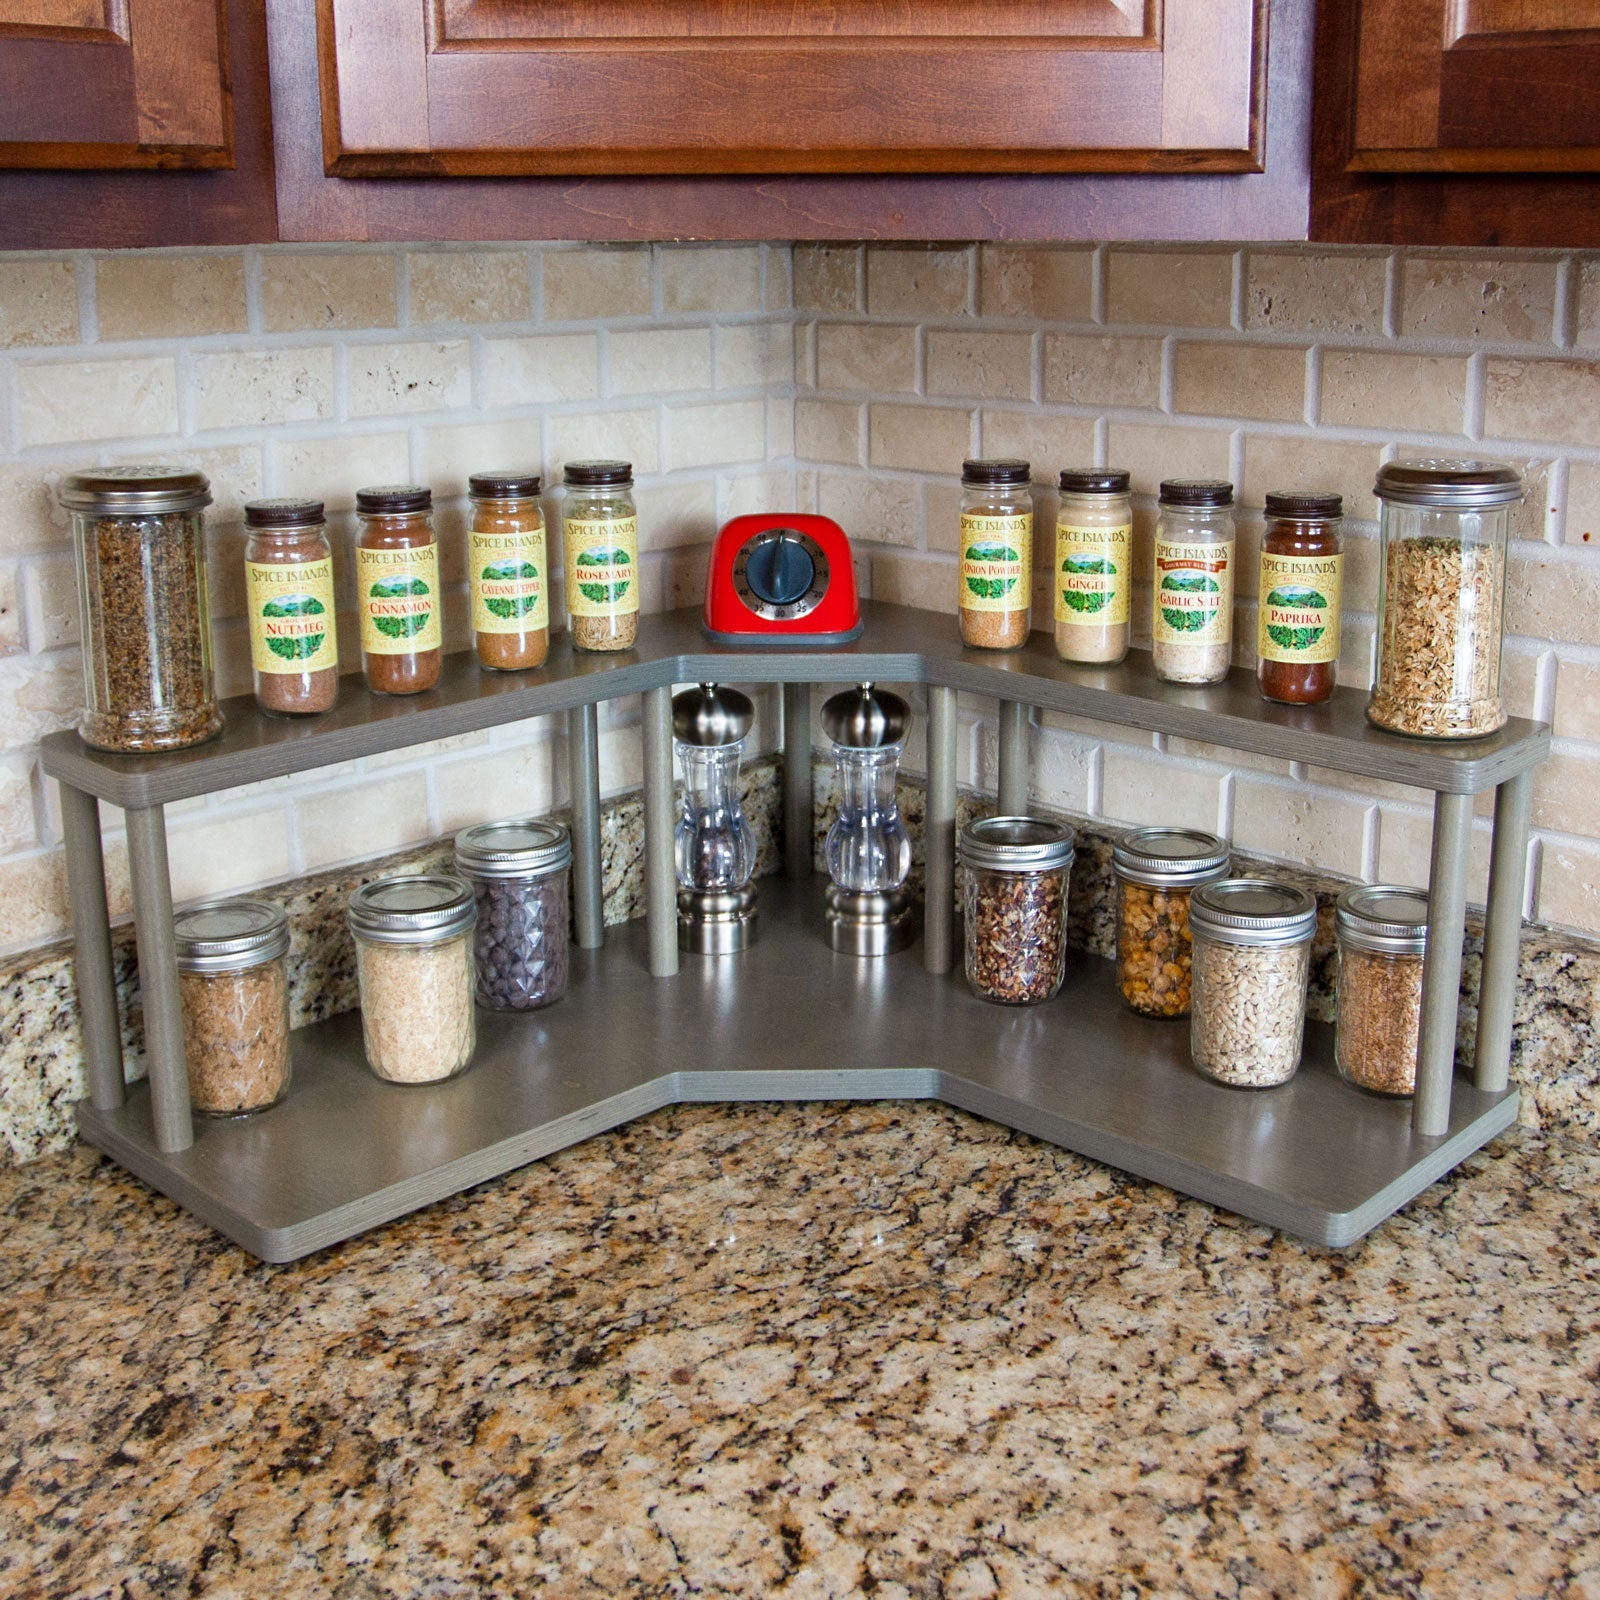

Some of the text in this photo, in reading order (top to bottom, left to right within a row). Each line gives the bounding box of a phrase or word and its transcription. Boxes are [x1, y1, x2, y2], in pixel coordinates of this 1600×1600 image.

[569, 523, 596, 535] SPICE
[961, 516, 1026, 531] SPICE ISLANDS
[473, 533, 543, 548] SPICE ISLANDS
[1057, 528, 1125, 543] SPICE ISLANDS
[360, 546, 435, 564] SPICE ISLANDS
[1157, 544, 1228, 559] SPICE ISLANDS
[964, 562, 1020, 576] ONION POWDER
[1262, 558, 1337, 574] SPICE ISLANDS
[252, 564, 329, 583] SPICE ISLANDS
[576, 567, 633, 580] ROSEMARY
[481, 581, 541, 595] CAYENNE PEPPER
[1068, 578, 1107, 590] GINGER
[1160, 592, 1194, 606] GARLIC
[369, 600, 432, 615] CINNAMON
[797, 605, 807, 613] 25
[1271, 610, 1322, 624] PAPRIKA
[266, 622, 324, 635] NUTMEG
